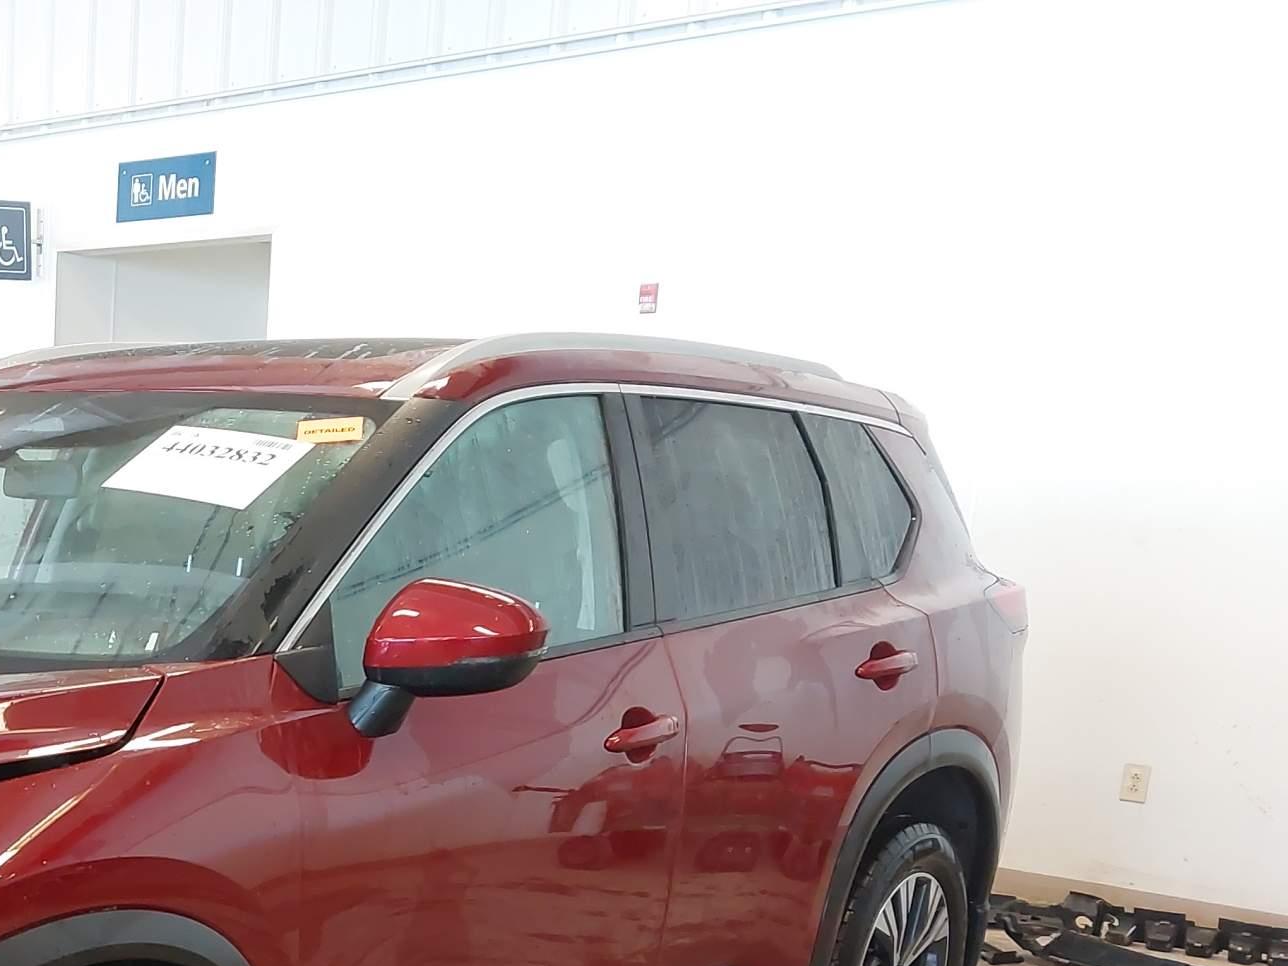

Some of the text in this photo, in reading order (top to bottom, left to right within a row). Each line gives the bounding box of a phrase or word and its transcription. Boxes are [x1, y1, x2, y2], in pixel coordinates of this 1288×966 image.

[158, 173, 200, 202] Men
[303, 426, 356, 436] DETAILED
[161, 440, 278, 466] 44032832
